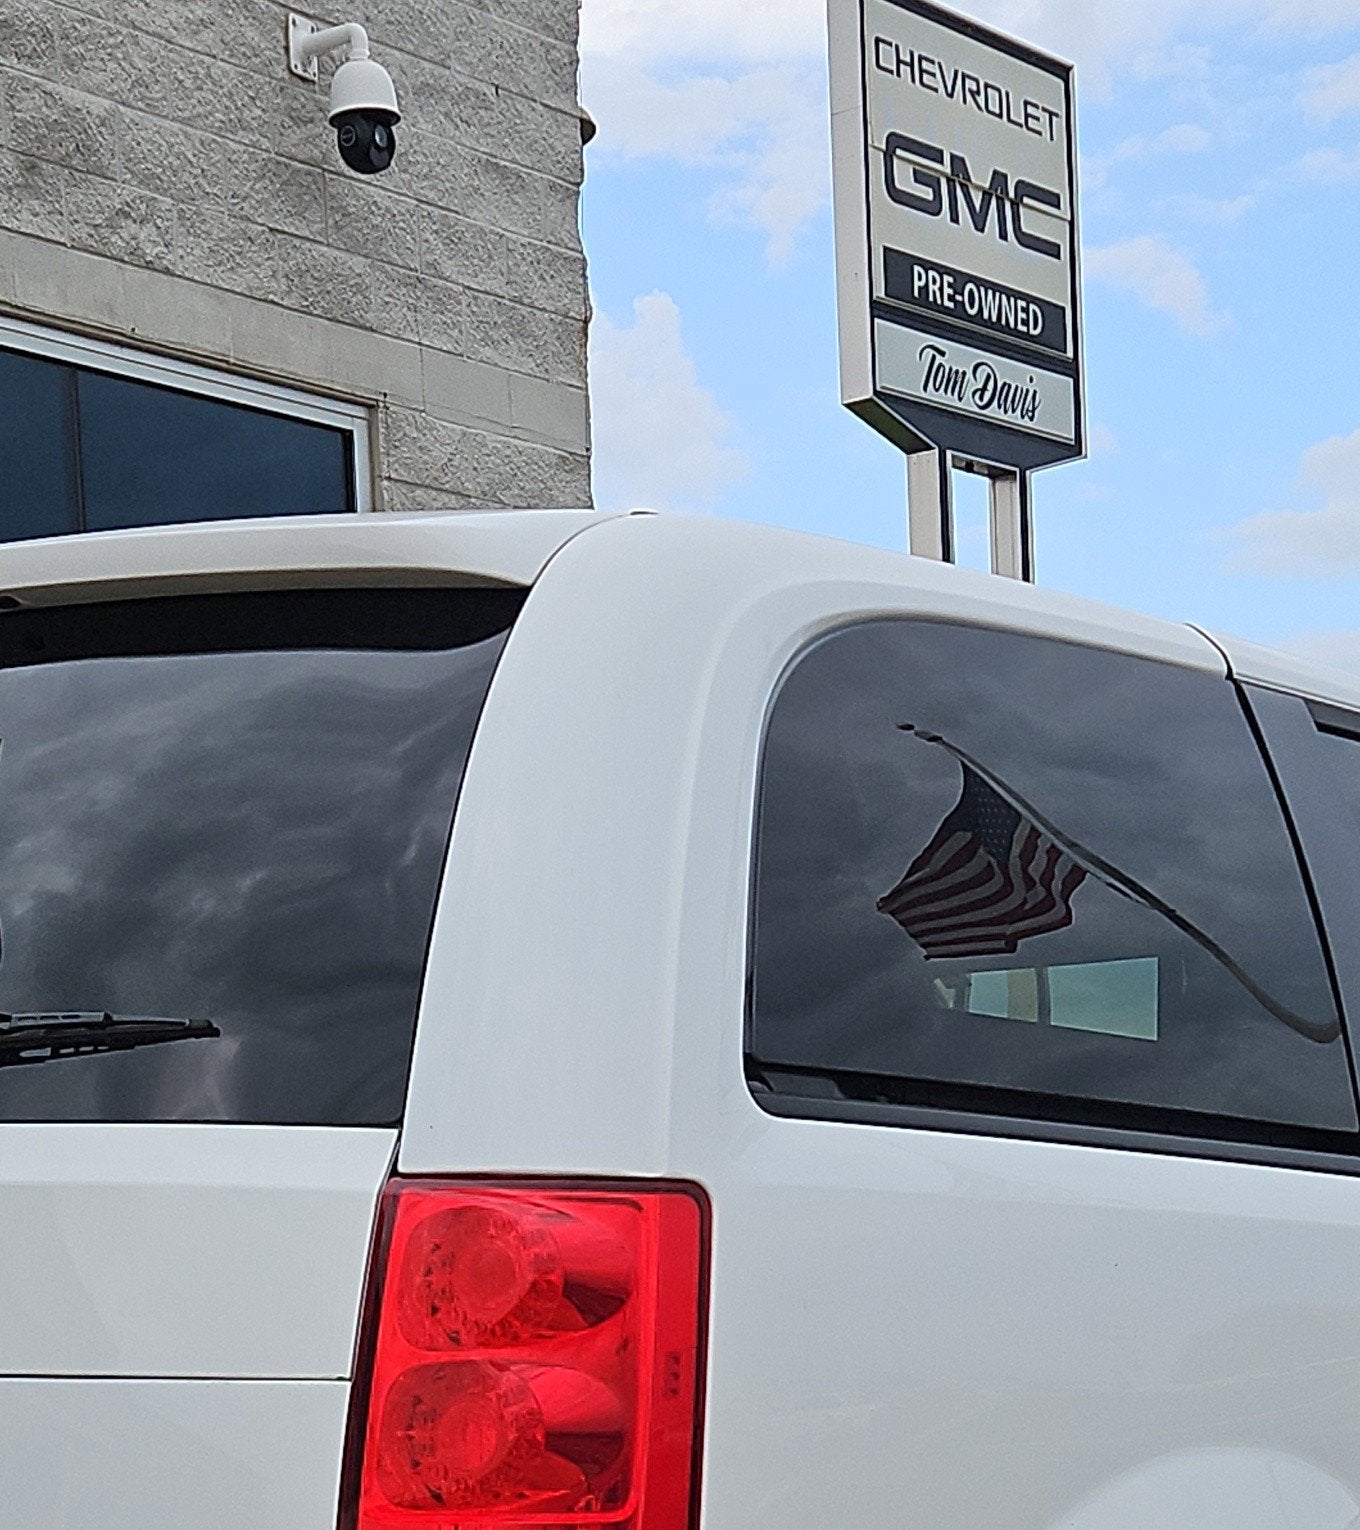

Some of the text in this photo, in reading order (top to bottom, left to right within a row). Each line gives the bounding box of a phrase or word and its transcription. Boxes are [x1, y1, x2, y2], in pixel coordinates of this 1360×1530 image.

[874, 35, 1060, 142] CHEVROLET
[883, 131, 1062, 261] GMC
[912, 263, 1044, 338] PRE-OWNED
[919, 344, 1041, 423] Tom Davis
